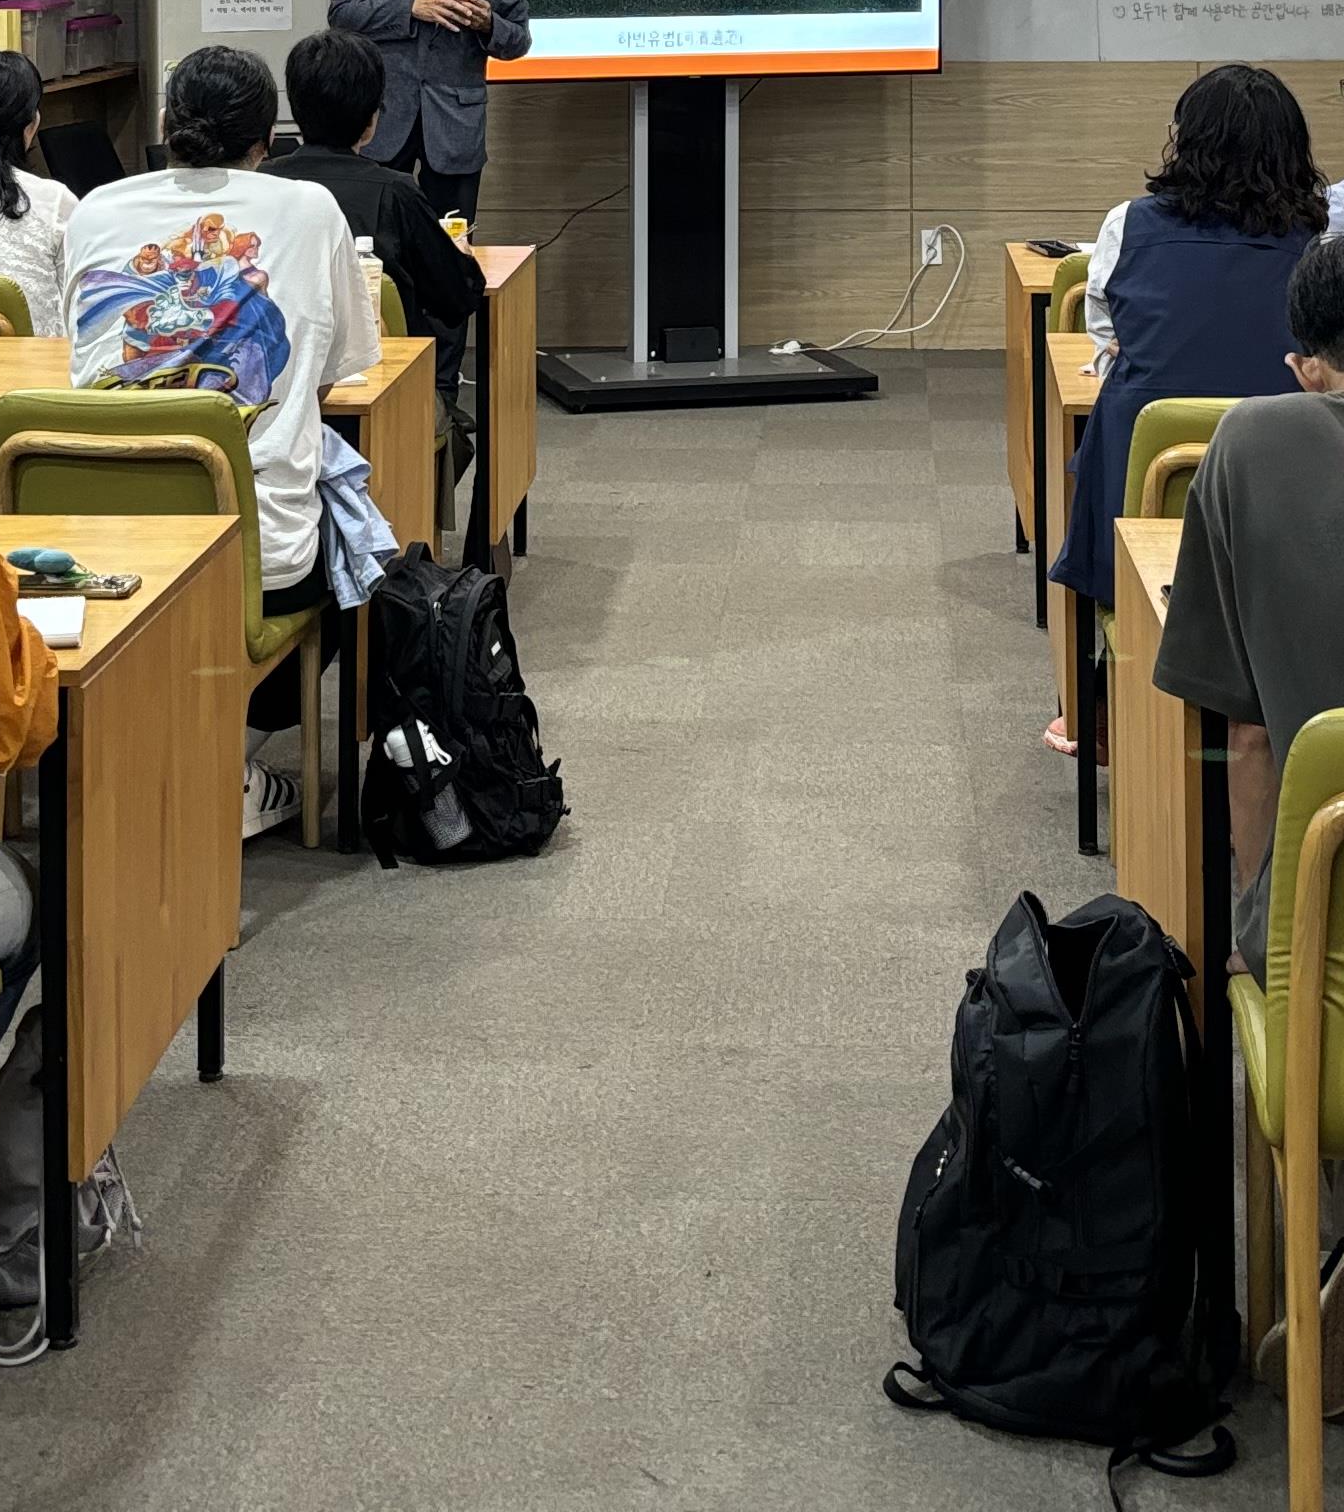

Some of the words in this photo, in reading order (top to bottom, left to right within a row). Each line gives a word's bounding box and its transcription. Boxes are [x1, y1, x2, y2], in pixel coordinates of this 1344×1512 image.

[1133, 2, 1168, 22] 모두가
[1173, 3, 1198, 21] 함께
[1202, 2, 1248, 22] 사용하는
[1251, 2, 1310, 21] 공간입니다
